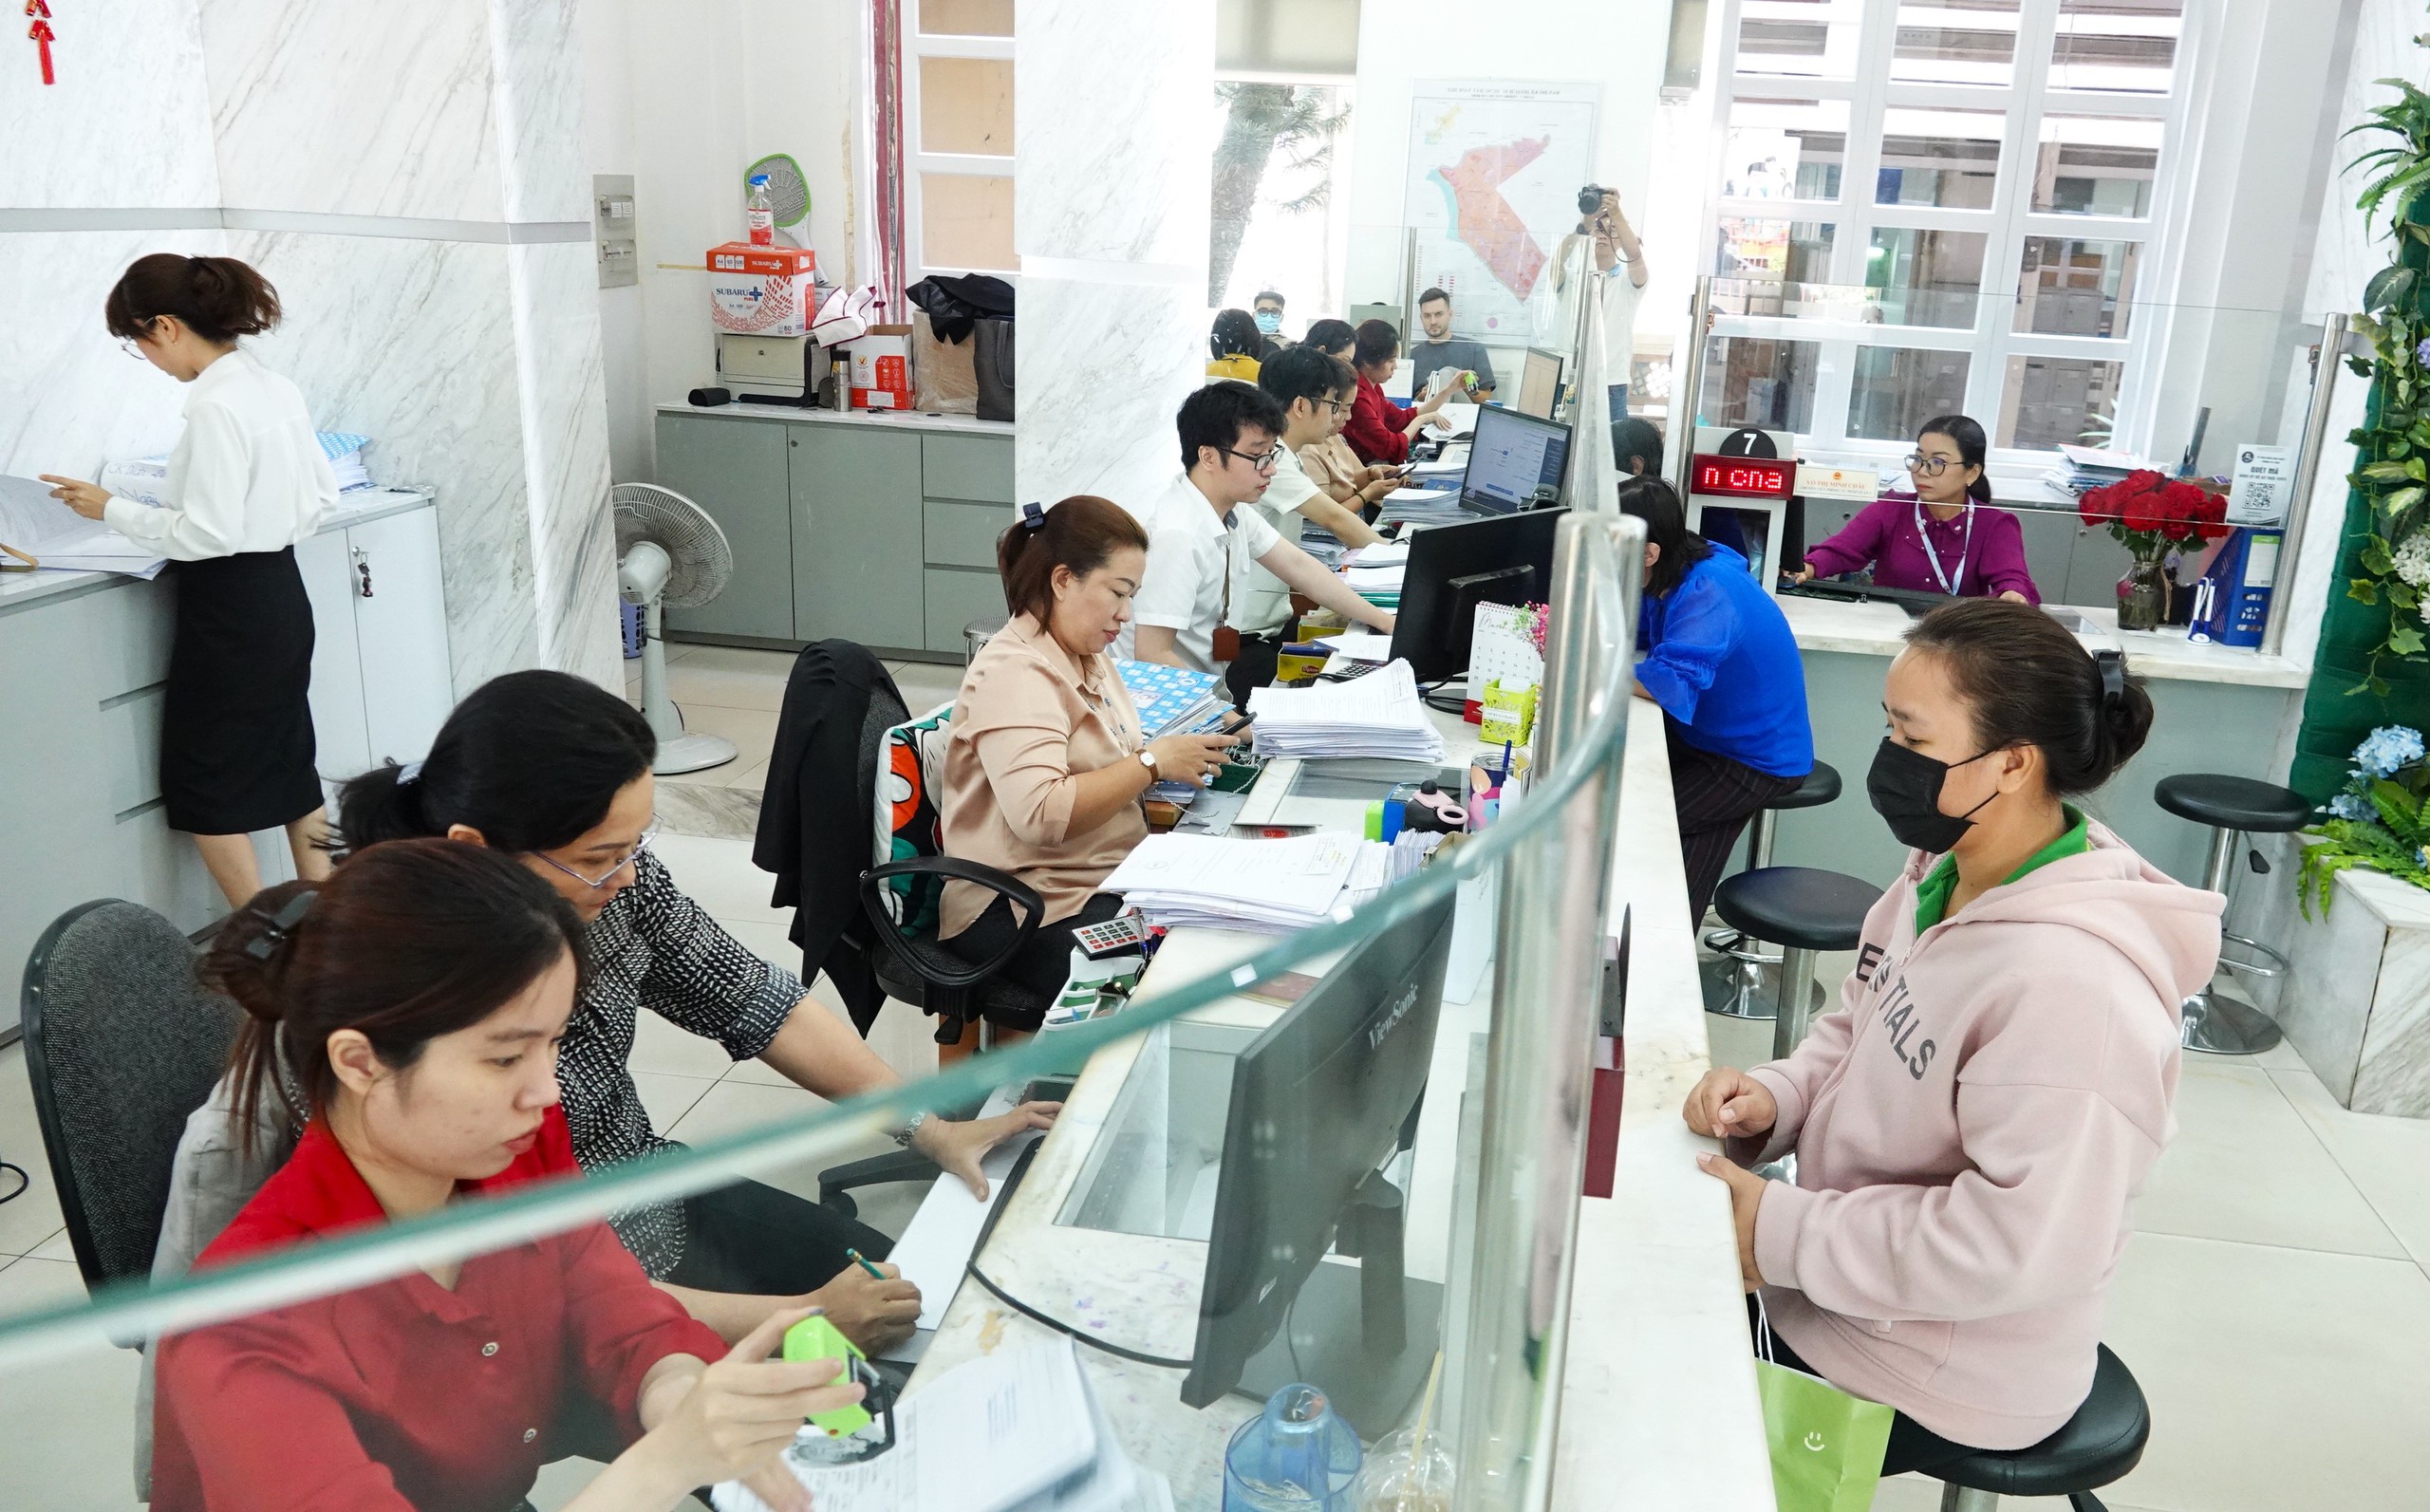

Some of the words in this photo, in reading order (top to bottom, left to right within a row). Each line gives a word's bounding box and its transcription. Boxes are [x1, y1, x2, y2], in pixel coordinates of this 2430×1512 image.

[717, 288, 749, 296] SUBARU
[1743, 433, 1757, 455] 7
[1369, 982, 1418, 1051] ViewSonic
